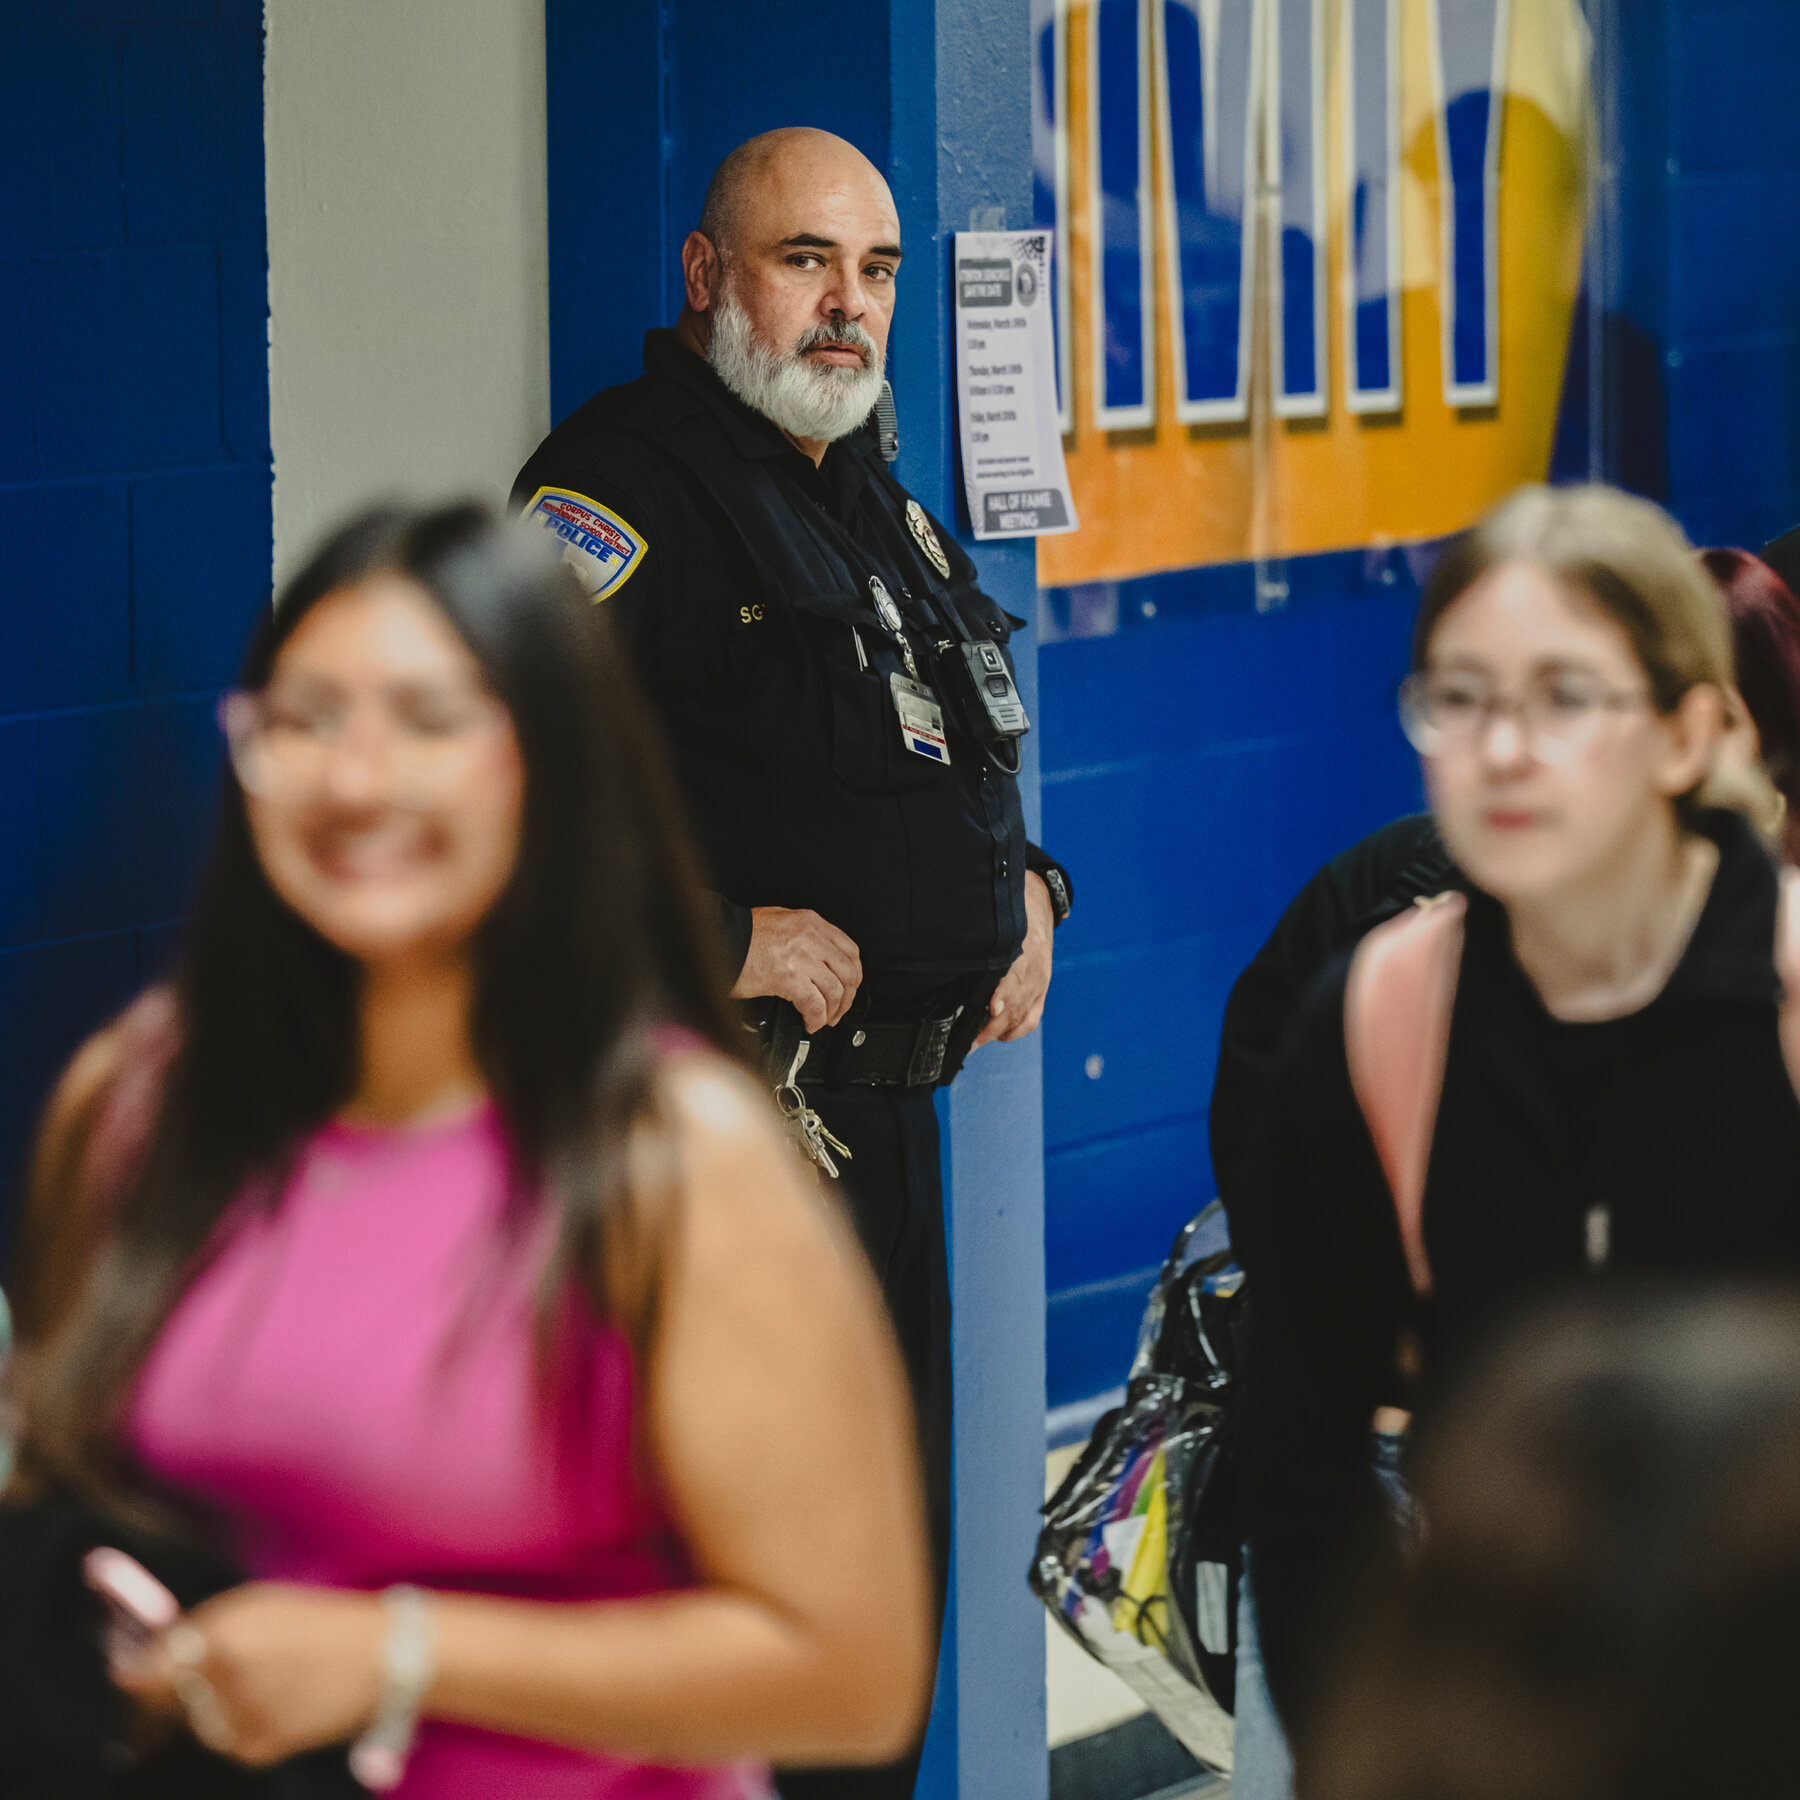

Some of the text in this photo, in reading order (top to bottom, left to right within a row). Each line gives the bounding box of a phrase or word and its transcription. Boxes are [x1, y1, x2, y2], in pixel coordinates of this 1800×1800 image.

[988, 491, 1051, 512] HALL OF FAME
[542, 501, 631, 556] INDEPENDENT SCHOOL DISTRICT
[559, 502, 622, 541] CORPUS CHRISTI
[999, 510, 1039, 530] MEETING
[543, 516, 614, 564] POLICE
[740, 603, 766, 624] SG
